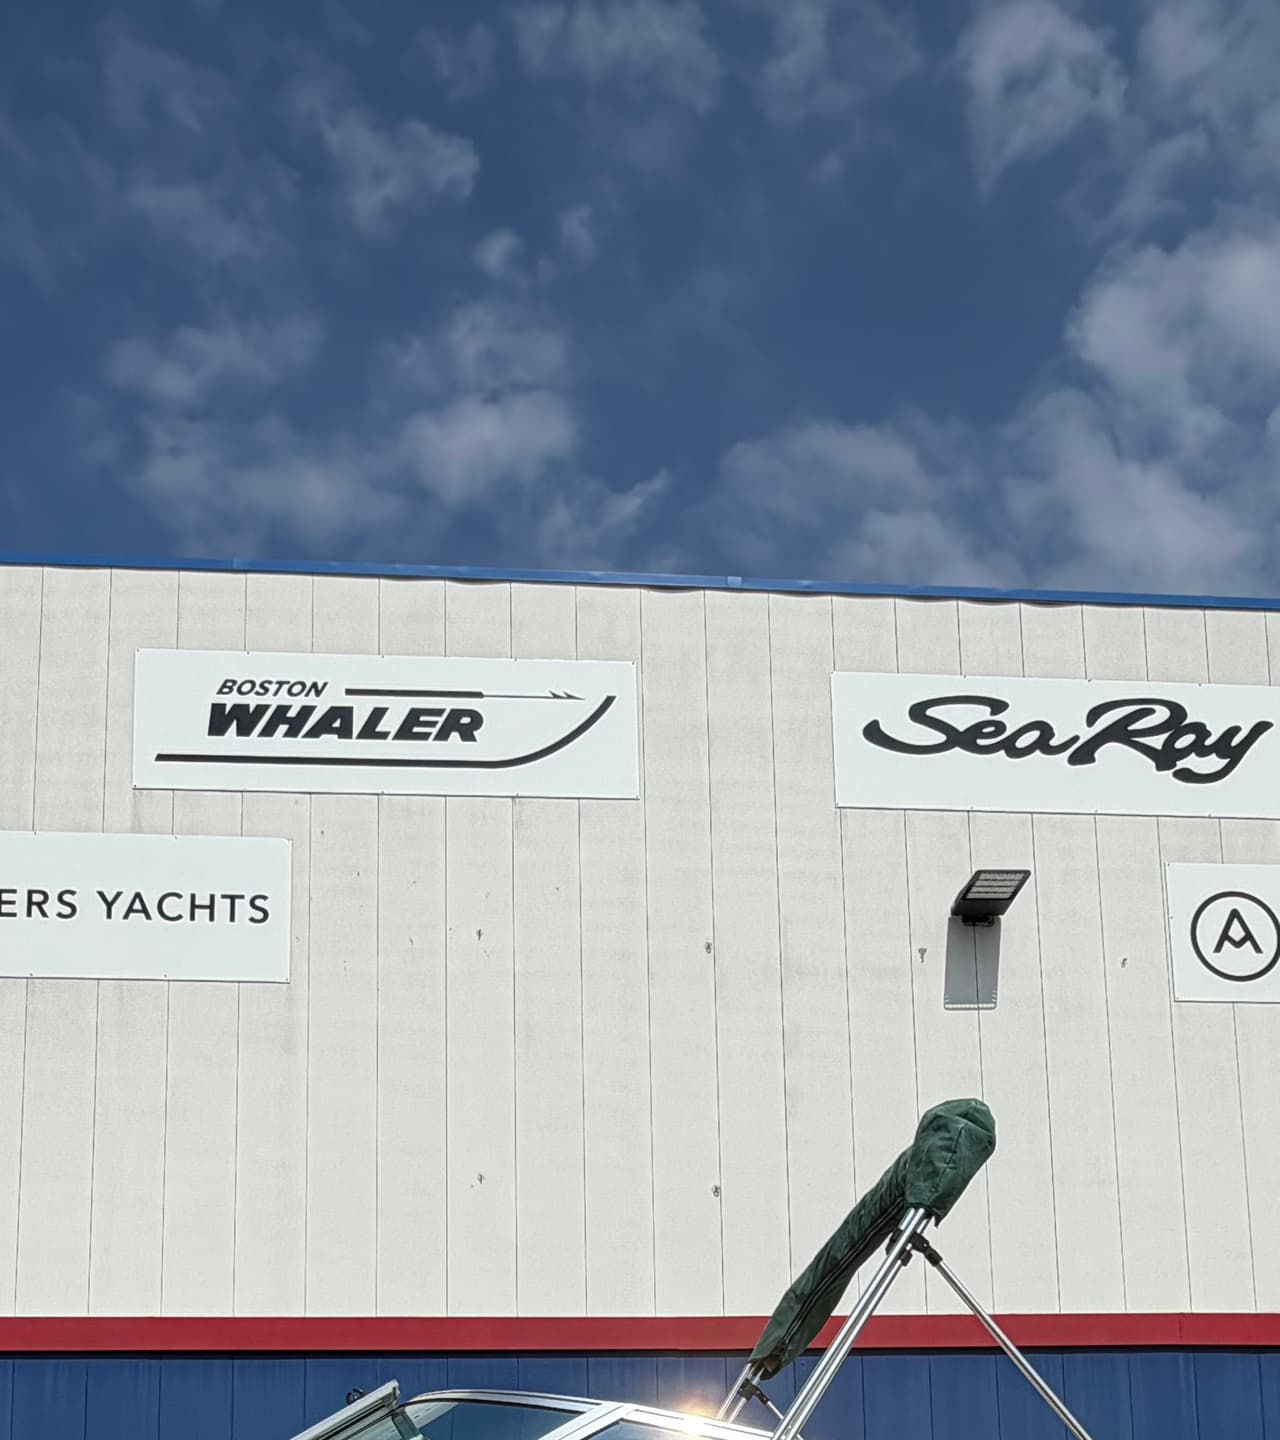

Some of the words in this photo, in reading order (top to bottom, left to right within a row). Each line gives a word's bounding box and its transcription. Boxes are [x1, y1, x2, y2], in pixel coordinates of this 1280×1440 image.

[215, 678, 329, 699] BOSTON
[207, 702, 485, 743] WHALER
[862, 694, 1082, 759] Sea
[1066, 697, 1274, 785] Ray
[96, 890, 271, 924] YACHTS
